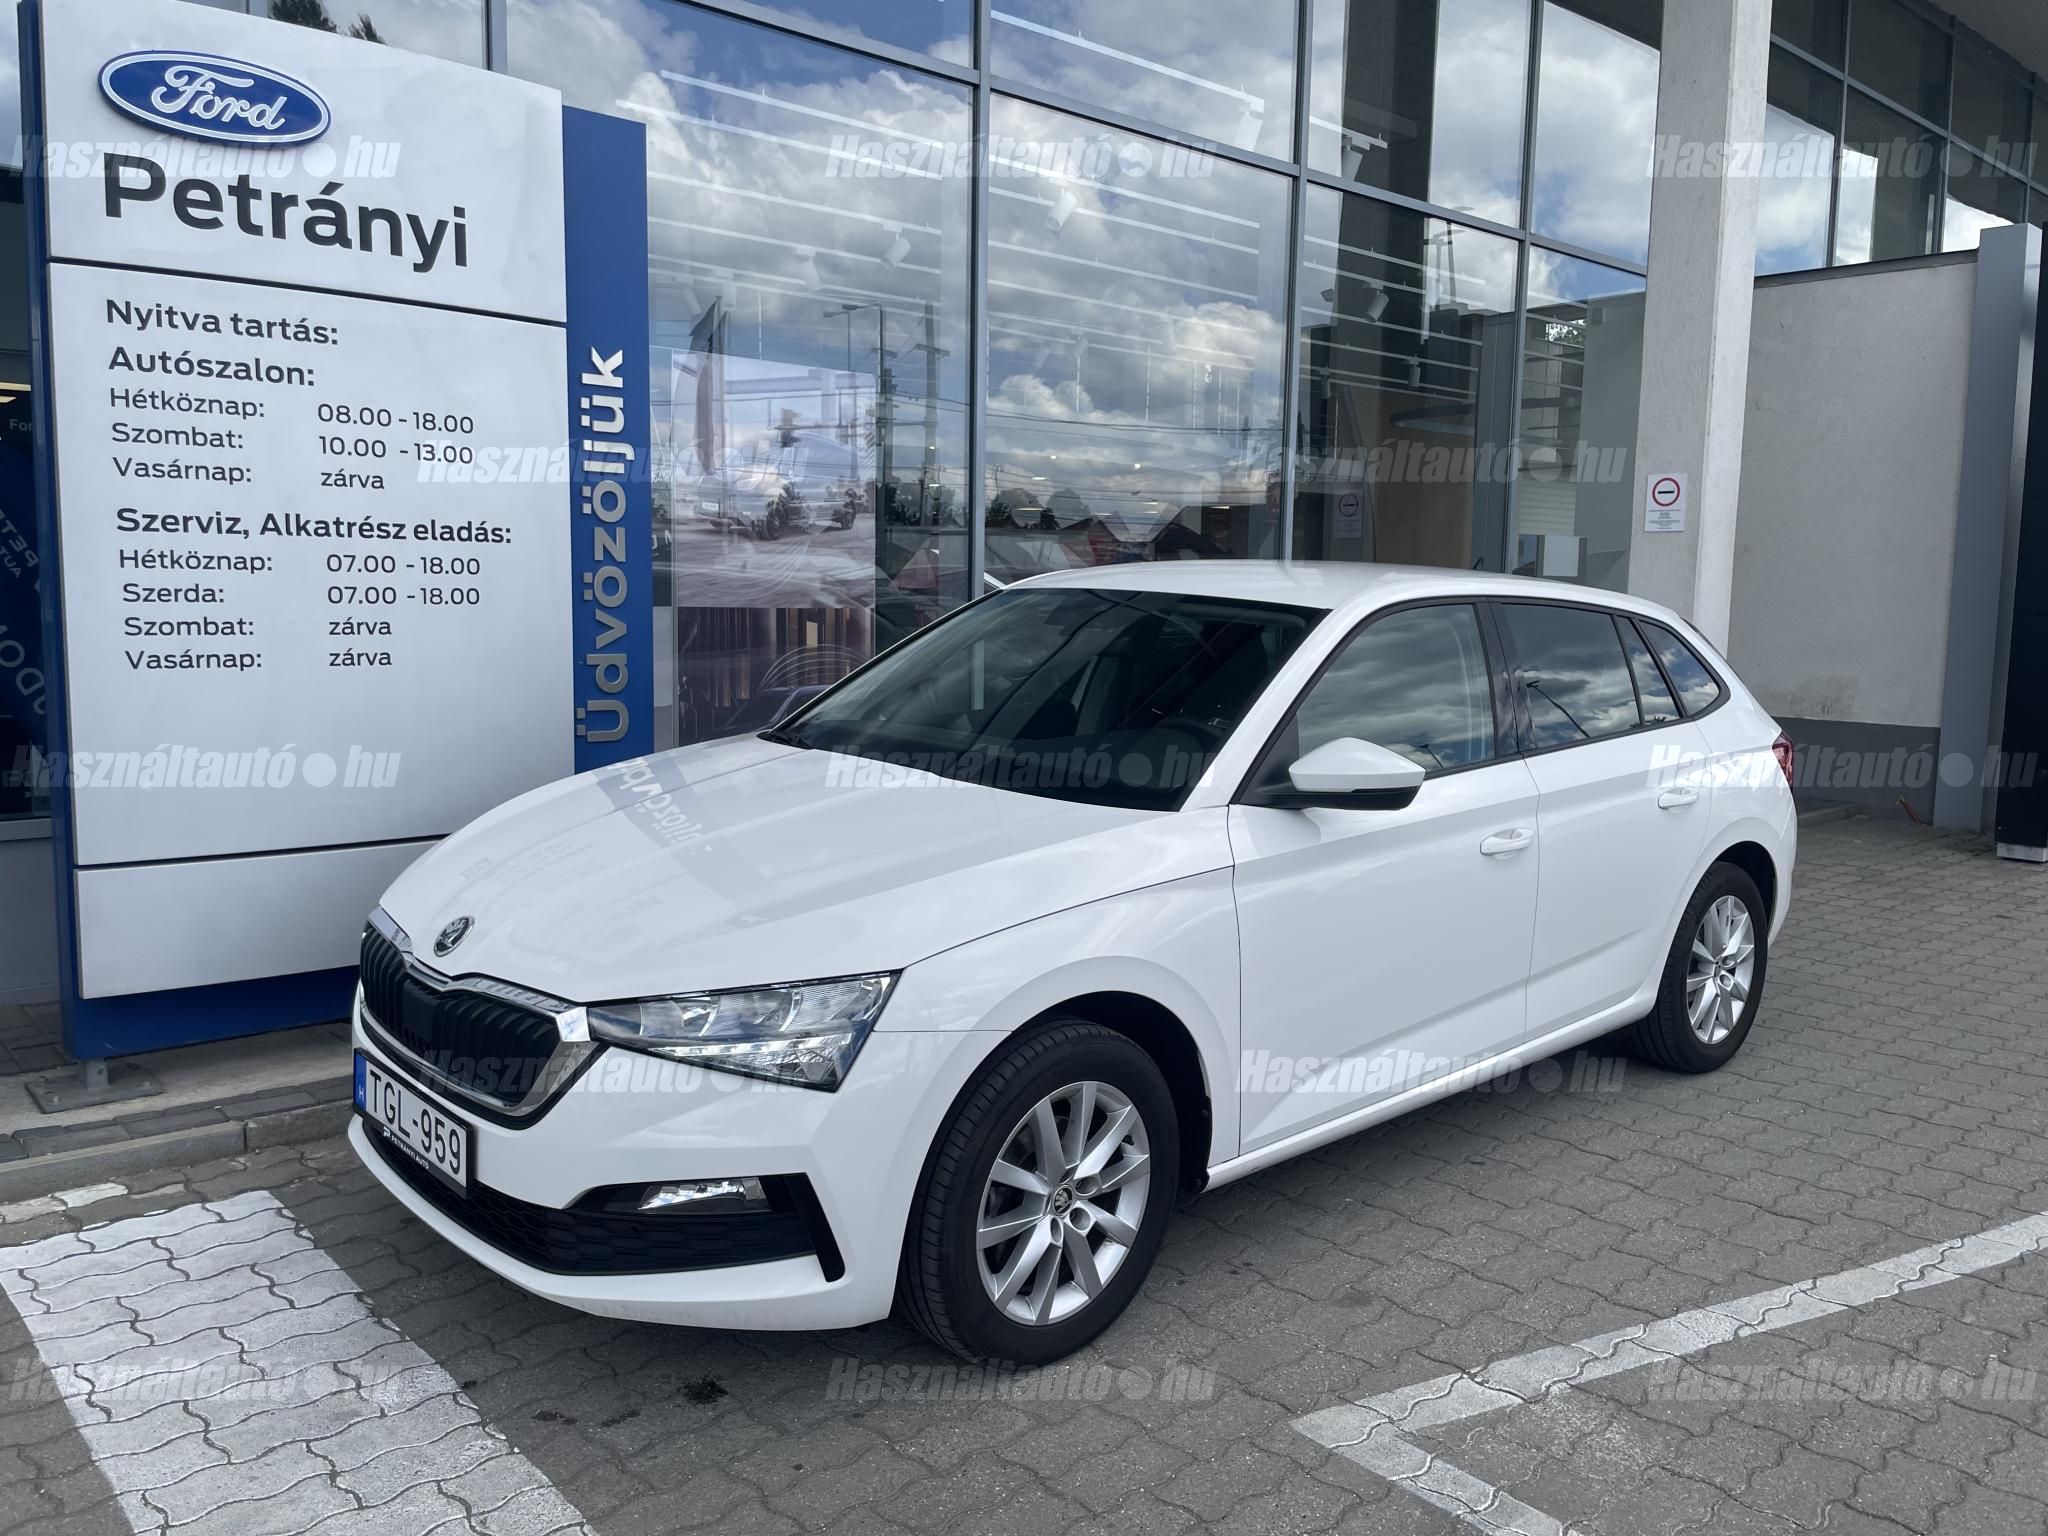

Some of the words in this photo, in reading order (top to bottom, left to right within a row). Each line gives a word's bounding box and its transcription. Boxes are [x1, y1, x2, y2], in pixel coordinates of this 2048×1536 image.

[151, 65, 287, 130] Ford
[102, 152, 469, 273] Petrányi
[106, 299, 222, 334] Nyitva
[229, 311, 339, 345] tartás:
[108, 346, 316, 388] Autószalon:
[110, 387, 265, 420] Hétköznap:
[317, 403, 392, 427] 08.00
[111, 422, 244, 449] Szombat:
[319, 435, 387, 458] 10.00
[112, 456, 252, 486] Vasárnap:
[320, 468, 385, 490] zárva
[116, 507, 250, 540] Szerviz,
[259, 512, 407, 540] Alkatrész
[413, 519, 512, 544] eladás:
[576, 346, 635, 742] Üdvözöljük
[119, 548, 273, 575] Hétköznap:
[326, 554, 396, 574] 07.00
[122, 582, 225, 604] Szerda:
[327, 585, 397, 605] 07.00
[124, 615, 255, 637] Szombat:
[328, 616, 393, 636] zárva
[124, 647, 263, 672] Vasárnap:
[329, 647, 393, 667] zárva
[369, 1069, 461, 1175] TGL-959
